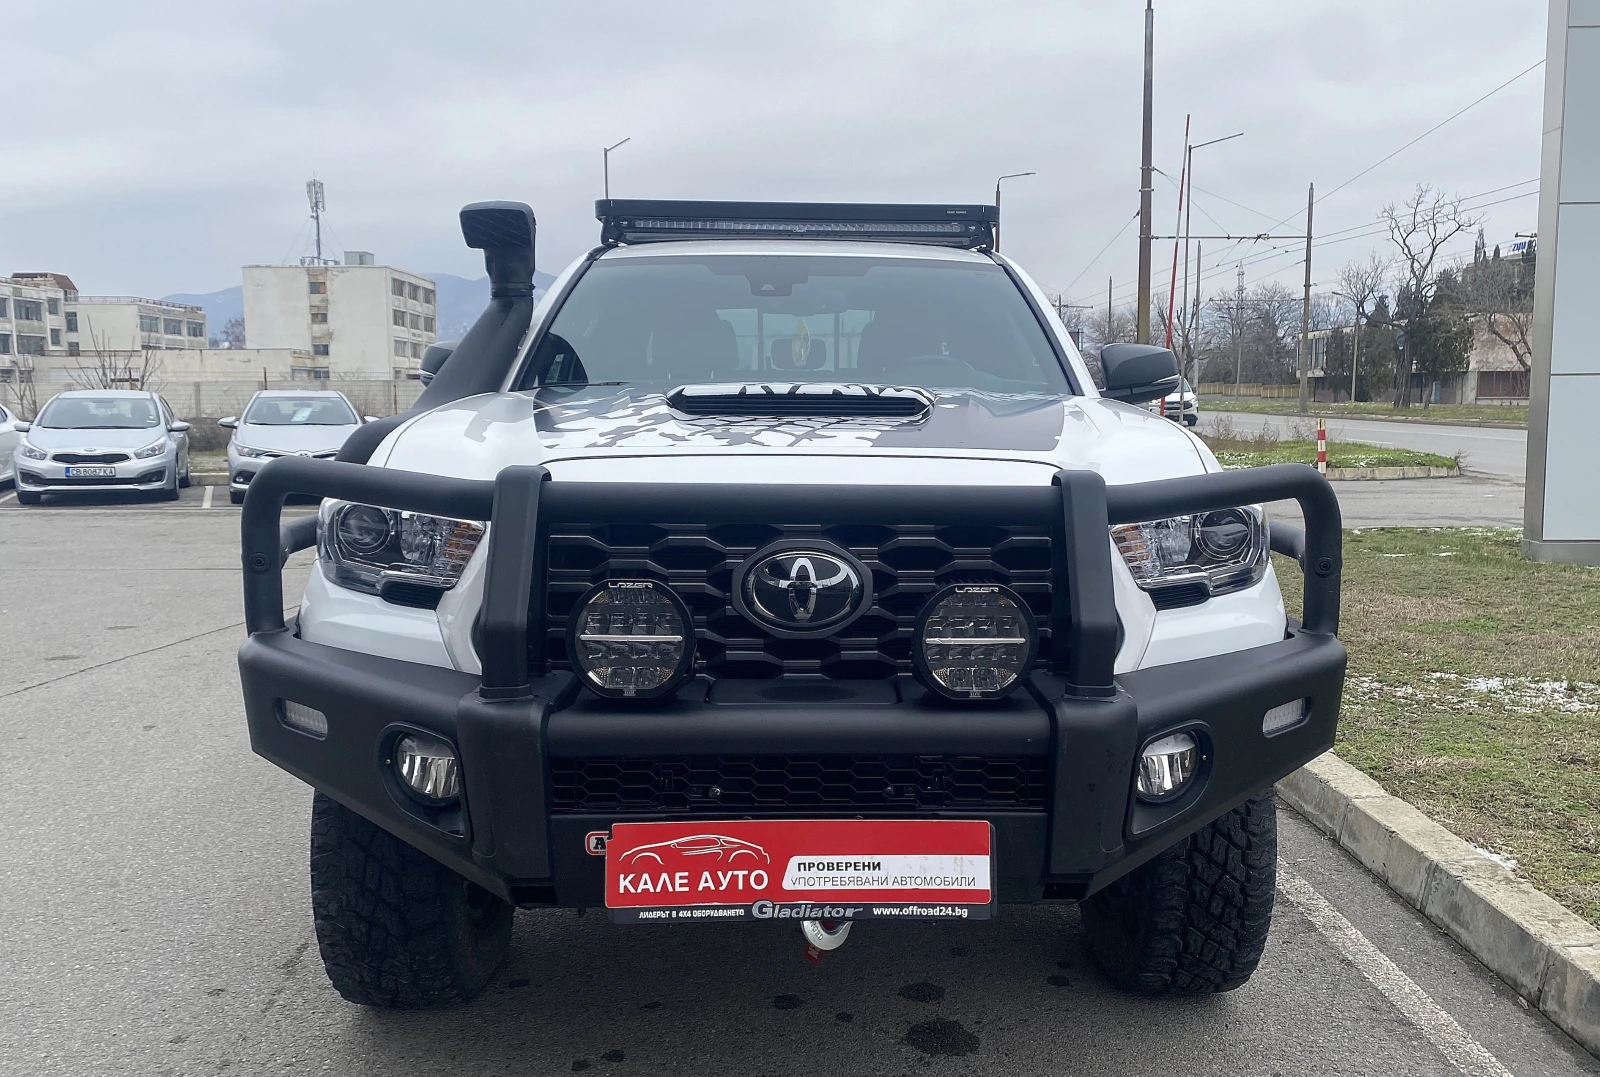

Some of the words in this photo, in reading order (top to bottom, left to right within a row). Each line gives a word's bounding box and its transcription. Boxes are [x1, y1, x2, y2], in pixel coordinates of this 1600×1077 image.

[797, 861, 881, 872] ПРОВЕРЕНИ
[618, 871, 690, 894] КАЛЕ
[697, 869, 769, 892] АУТО
[791, 875, 889, 887] УПОТРЕБЯВАНИ
[891, 875, 976, 887] АВТОМОБИЛИ
[638, 910, 670, 919] ЛИДЕРЪТ
[751, 899, 864, 919] Gladiator
[872, 906, 969, 918] www.offroad24.bg
